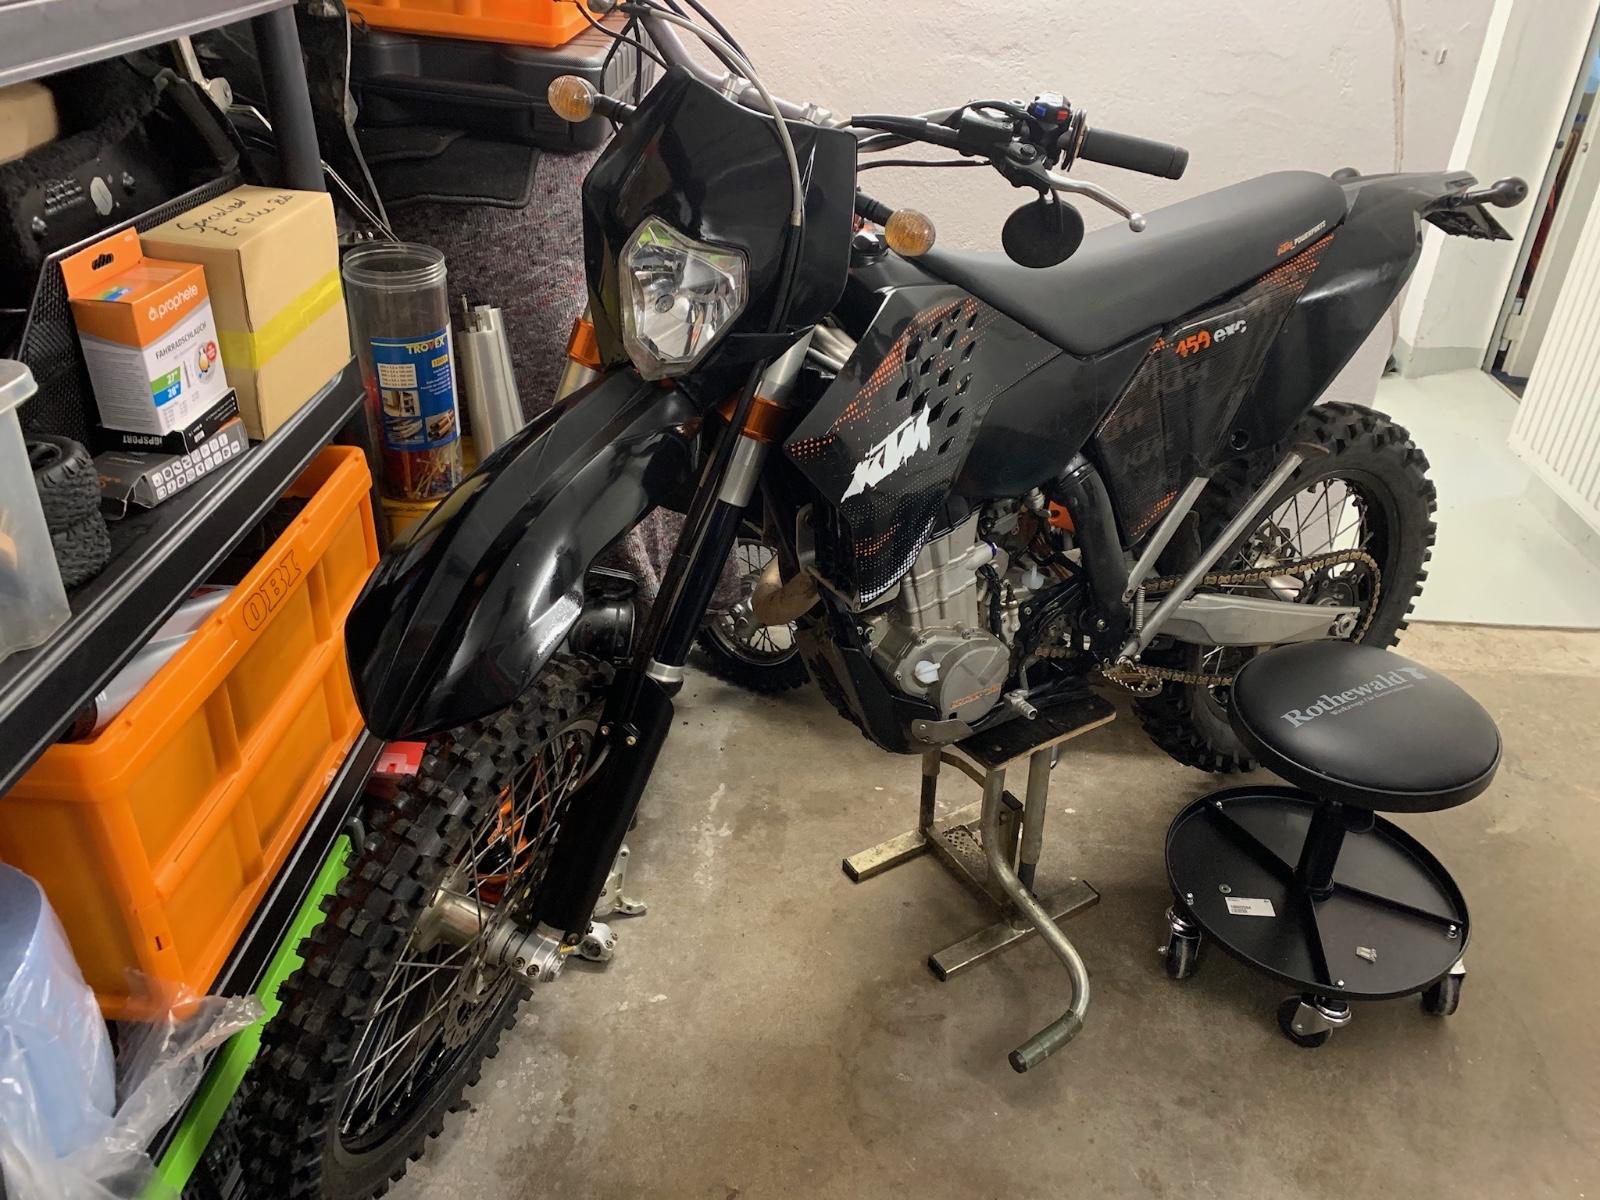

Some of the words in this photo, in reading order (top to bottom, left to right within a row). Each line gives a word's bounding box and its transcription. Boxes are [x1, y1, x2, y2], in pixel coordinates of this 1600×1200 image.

[158, 284, 199, 319] prophete
[155, 321, 207, 360] FAHRRADSCHLAUCH
[405, 336, 445, 354] TROVEX
[840, 401, 931, 504] KTM
[242, 548, 302, 632] OBI
[1280, 670, 1409, 729] Rothewald
